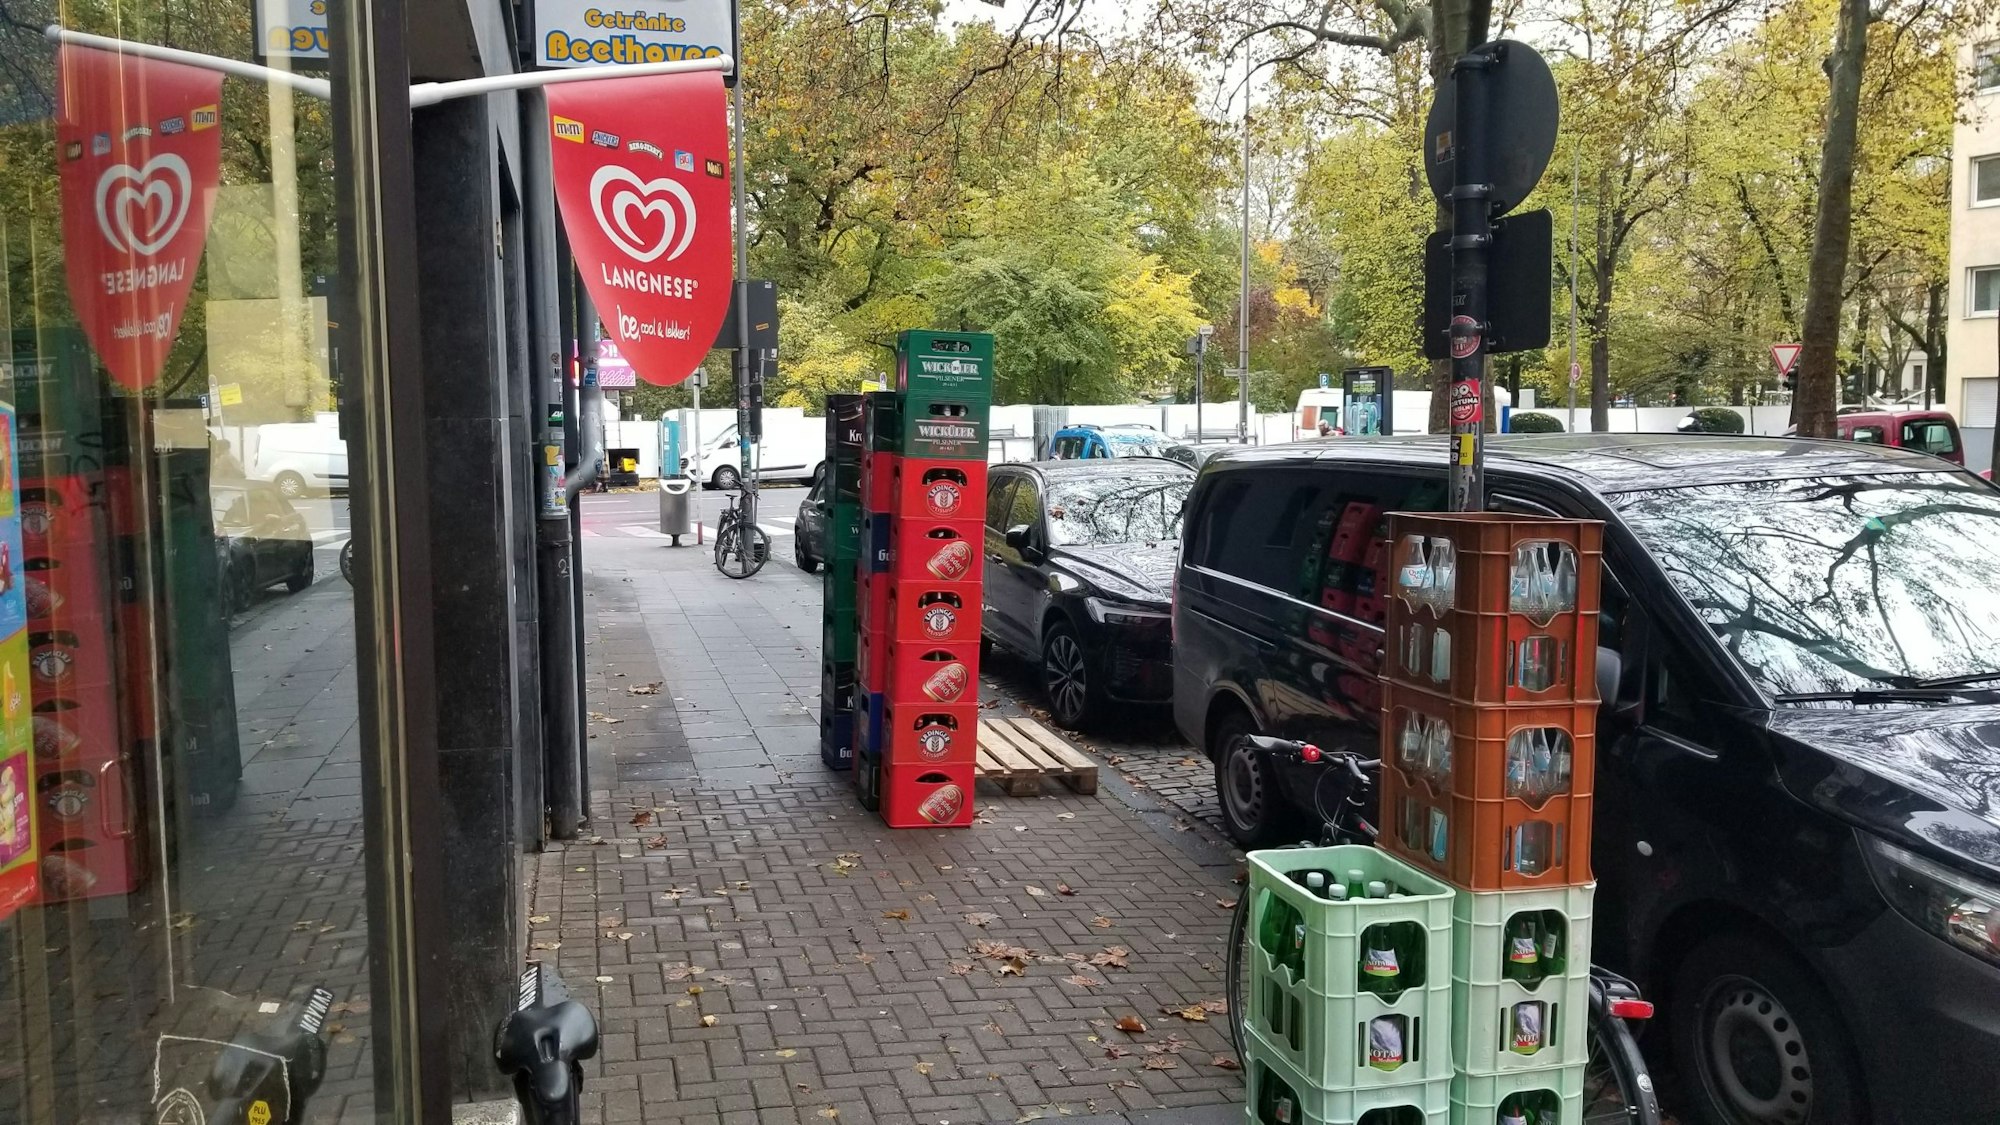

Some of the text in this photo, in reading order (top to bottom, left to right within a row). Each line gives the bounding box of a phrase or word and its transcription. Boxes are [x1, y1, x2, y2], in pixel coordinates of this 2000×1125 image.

[584, 8, 686, 32] Getränke
[918, 424, 976, 439] WICKÜLER
[928, 484, 959, 498] ERDINGER
[924, 607, 955, 621] ERDINGER
[920, 729, 951, 743] ERDINGER
[518, 966, 538, 1012] CANYON
